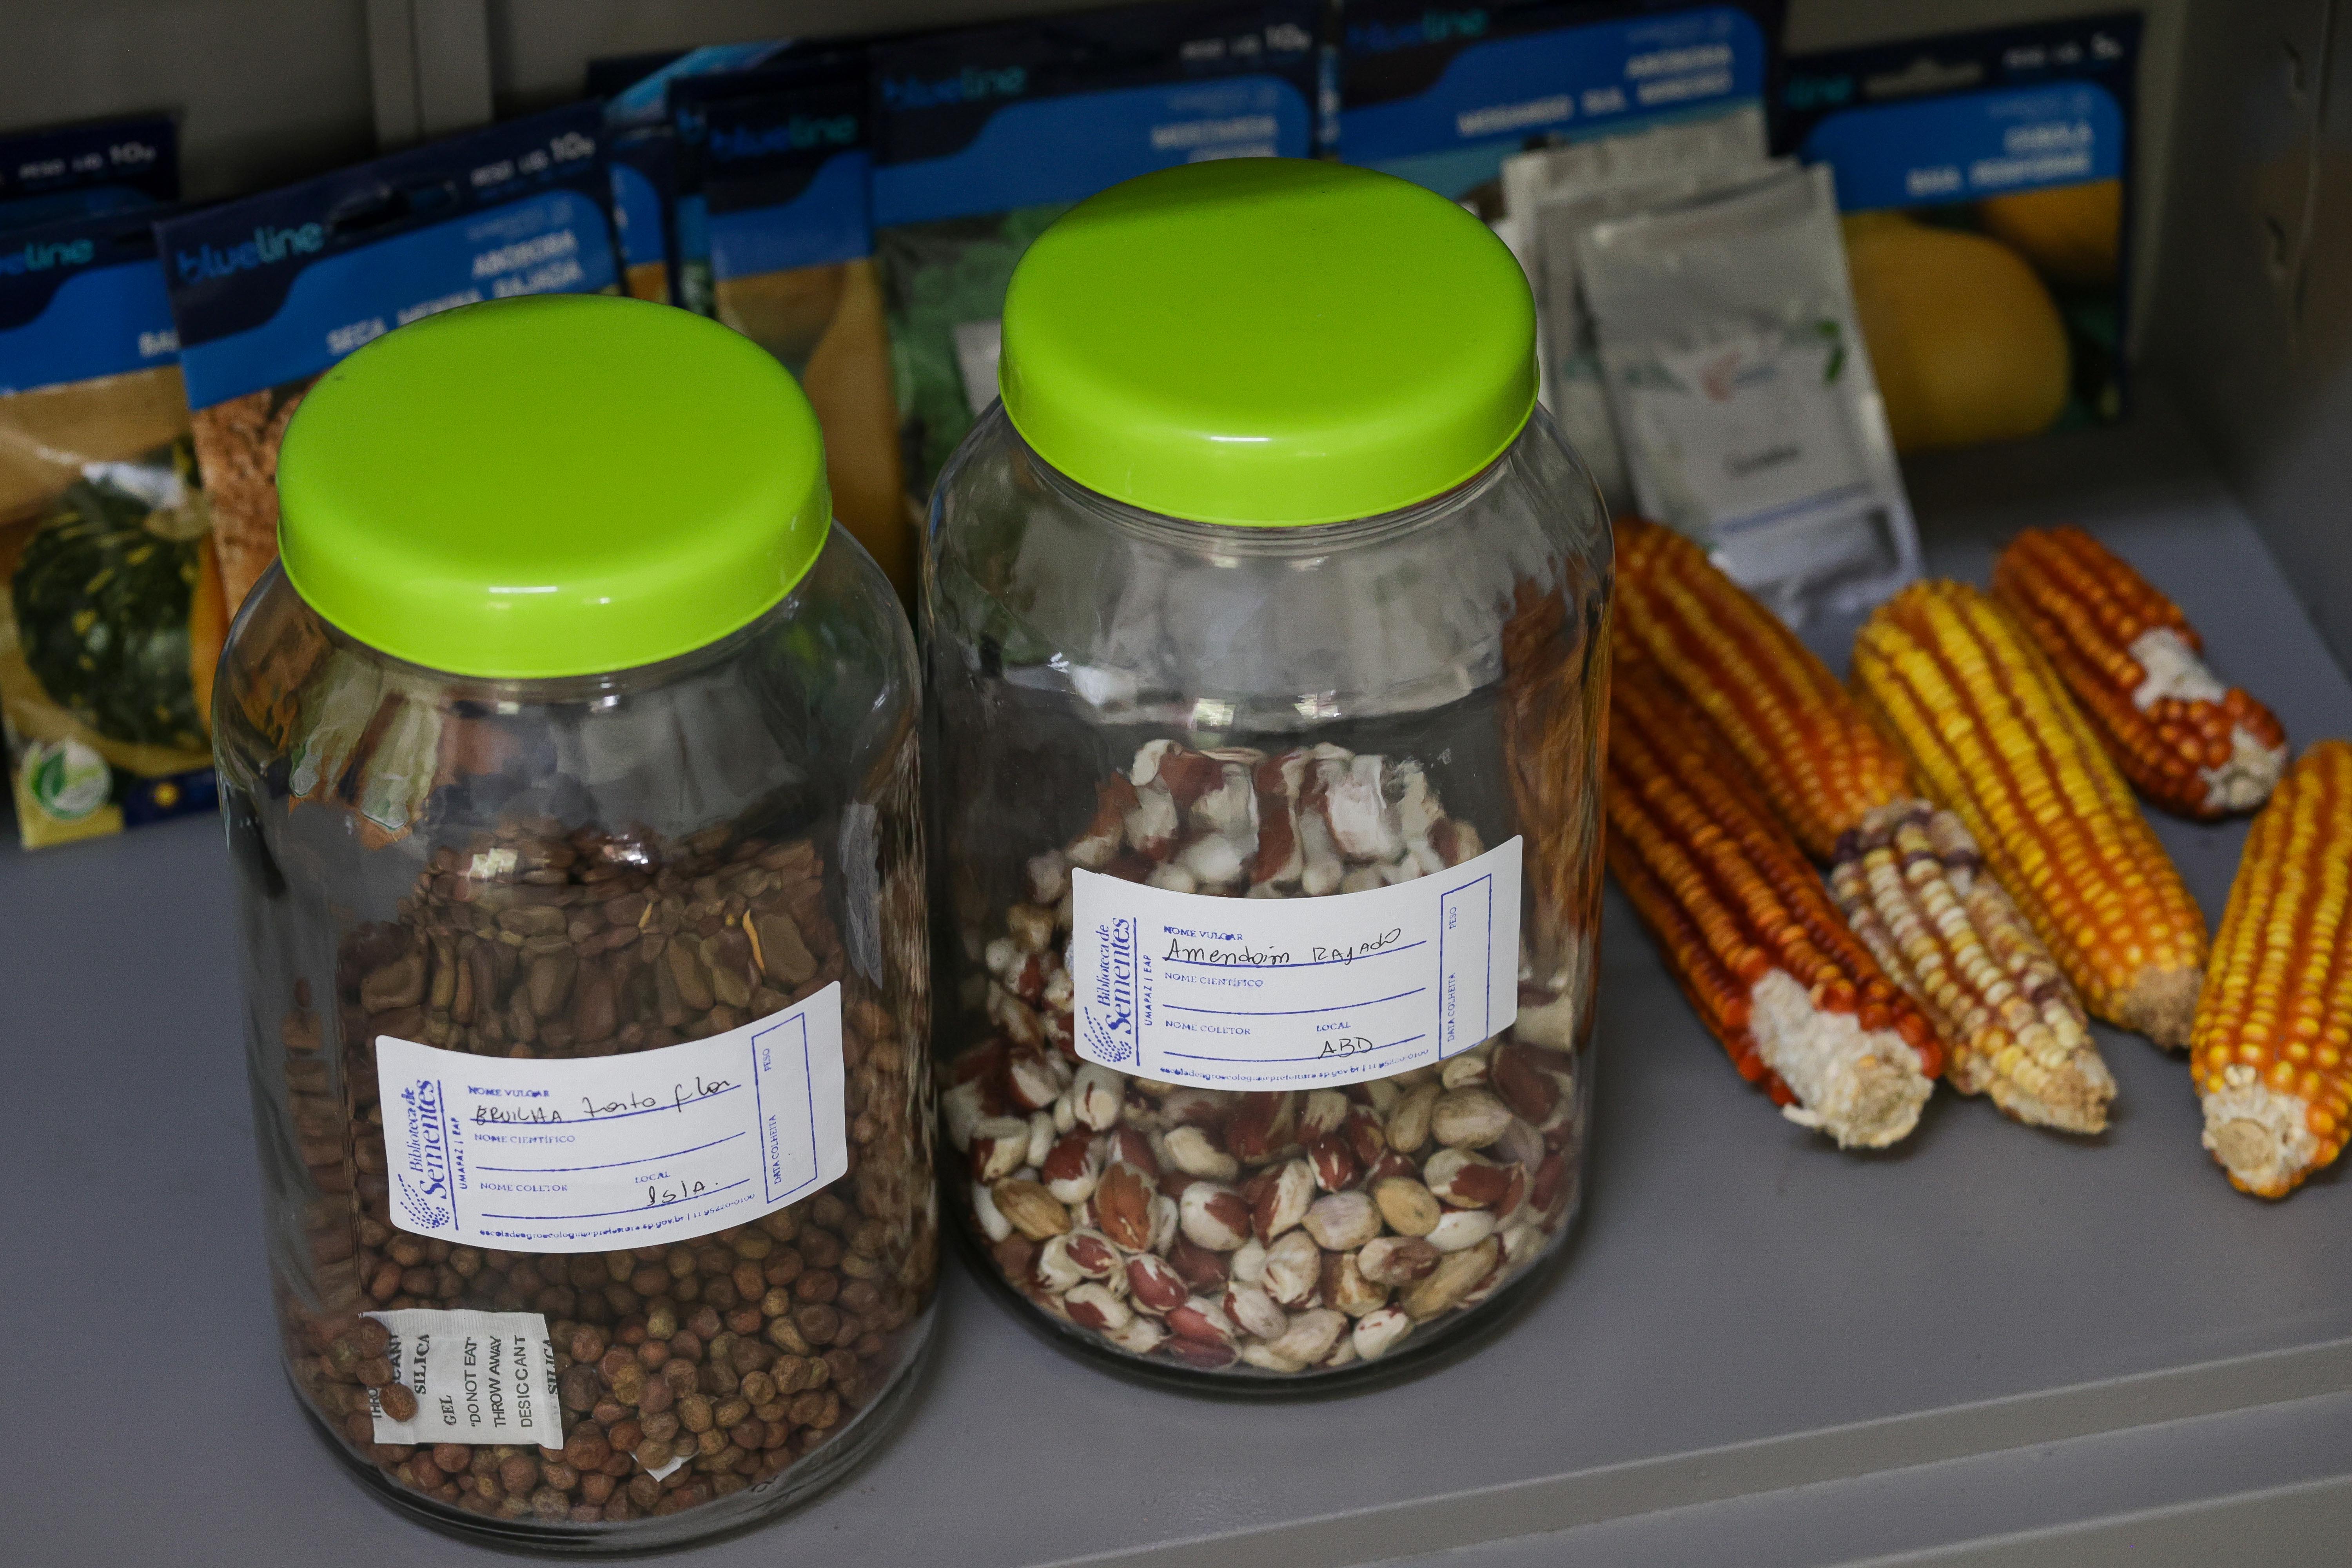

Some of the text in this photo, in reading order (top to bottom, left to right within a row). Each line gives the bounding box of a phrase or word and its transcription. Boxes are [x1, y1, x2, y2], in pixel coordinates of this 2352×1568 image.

[1163, 925, 1196, 937] NOME
[1095, 924, 1111, 1006] Biblioteca de
[1164, 938, 1290, 965] Amendoim
[1105, 917, 1132, 1034] Sementes
[1164, 972, 1197, 983] NOME
[1143, 985, 1153, 1026] UMAPAZ
[1165, 1020, 1197, 1031] NOME
[1316, 1022, 1351, 1033] LOCAL
[1317, 1036, 1373, 1059] ABD
[468, 1085, 502, 1096] NOME
[406, 1107, 424, 1173] Biblioteca
[416, 1079, 448, 1200] Sementes
[474, 1134, 507, 1143] NOME
[769, 1114, 782, 1185] DATA COLHEITA
[480, 1183, 513, 1192] NOME
[635, 1171, 671, 1184] LOCAL
[413, 1334, 430, 1395] SILICA
[464, 1369, 478, 1402] NOT
[488, 1335, 507, 1428] THROW AWAY
[514, 1334, 533, 1428] DESICCANT
[439, 1394, 457, 1426] GEL
